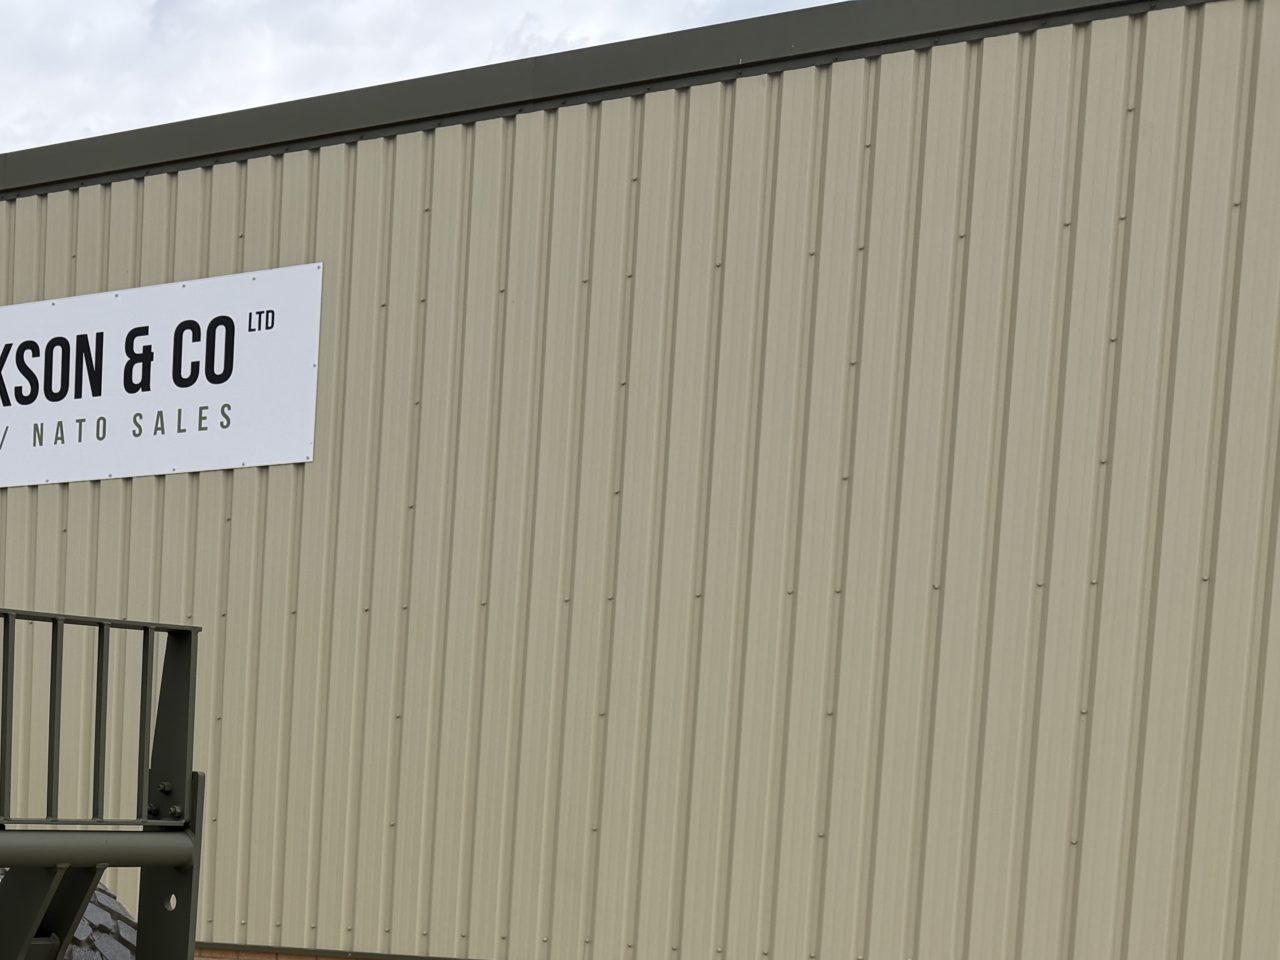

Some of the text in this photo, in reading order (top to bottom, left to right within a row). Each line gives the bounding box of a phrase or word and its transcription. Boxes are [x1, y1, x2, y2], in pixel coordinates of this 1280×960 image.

[122, 325, 155, 395] &
[171, 314, 236, 389] CO
[247, 309, 276, 333] LTD
[32, 416, 107, 448] NATO
[131, 403, 232, 438] SALES
